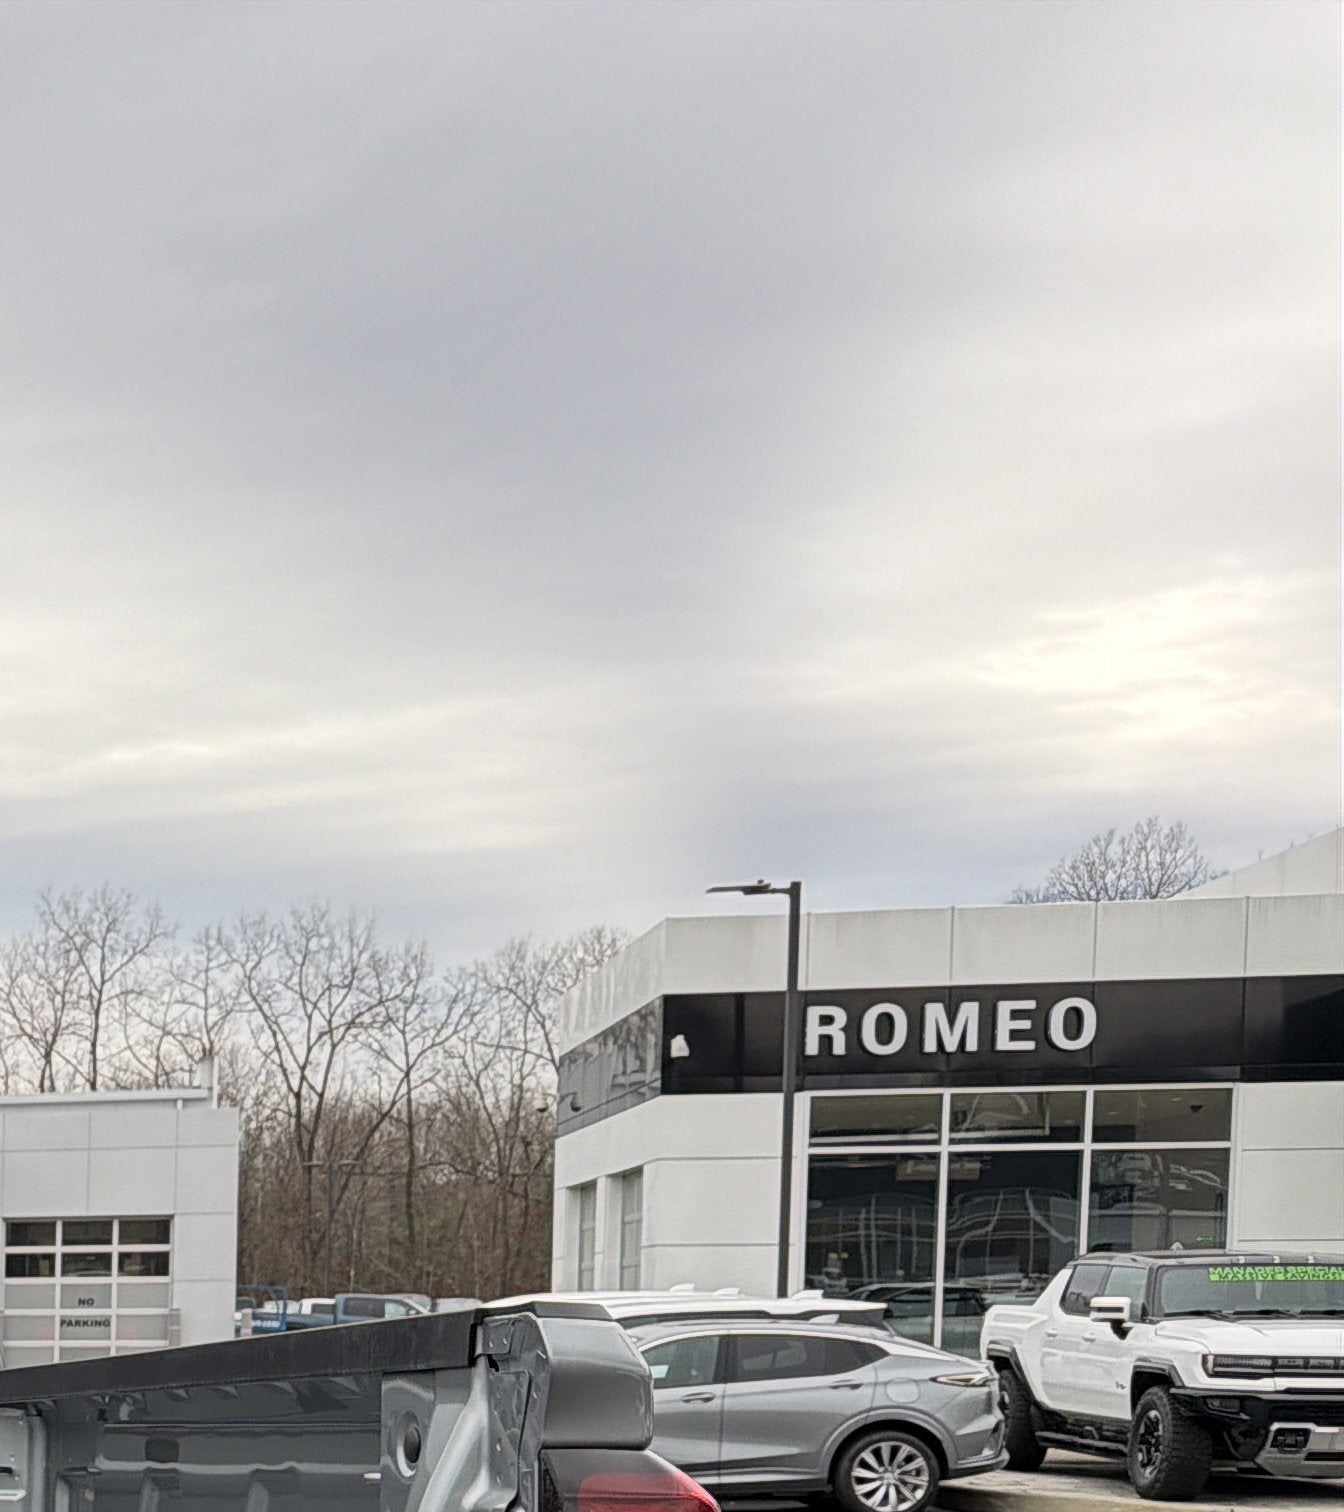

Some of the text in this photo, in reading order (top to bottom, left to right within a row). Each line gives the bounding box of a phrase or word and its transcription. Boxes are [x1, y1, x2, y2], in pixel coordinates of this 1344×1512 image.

[804, 997, 1097, 1056] ROMEO
[77, 1297, 95, 1306] NO
[60, 1318, 111, 1328] PARKING
